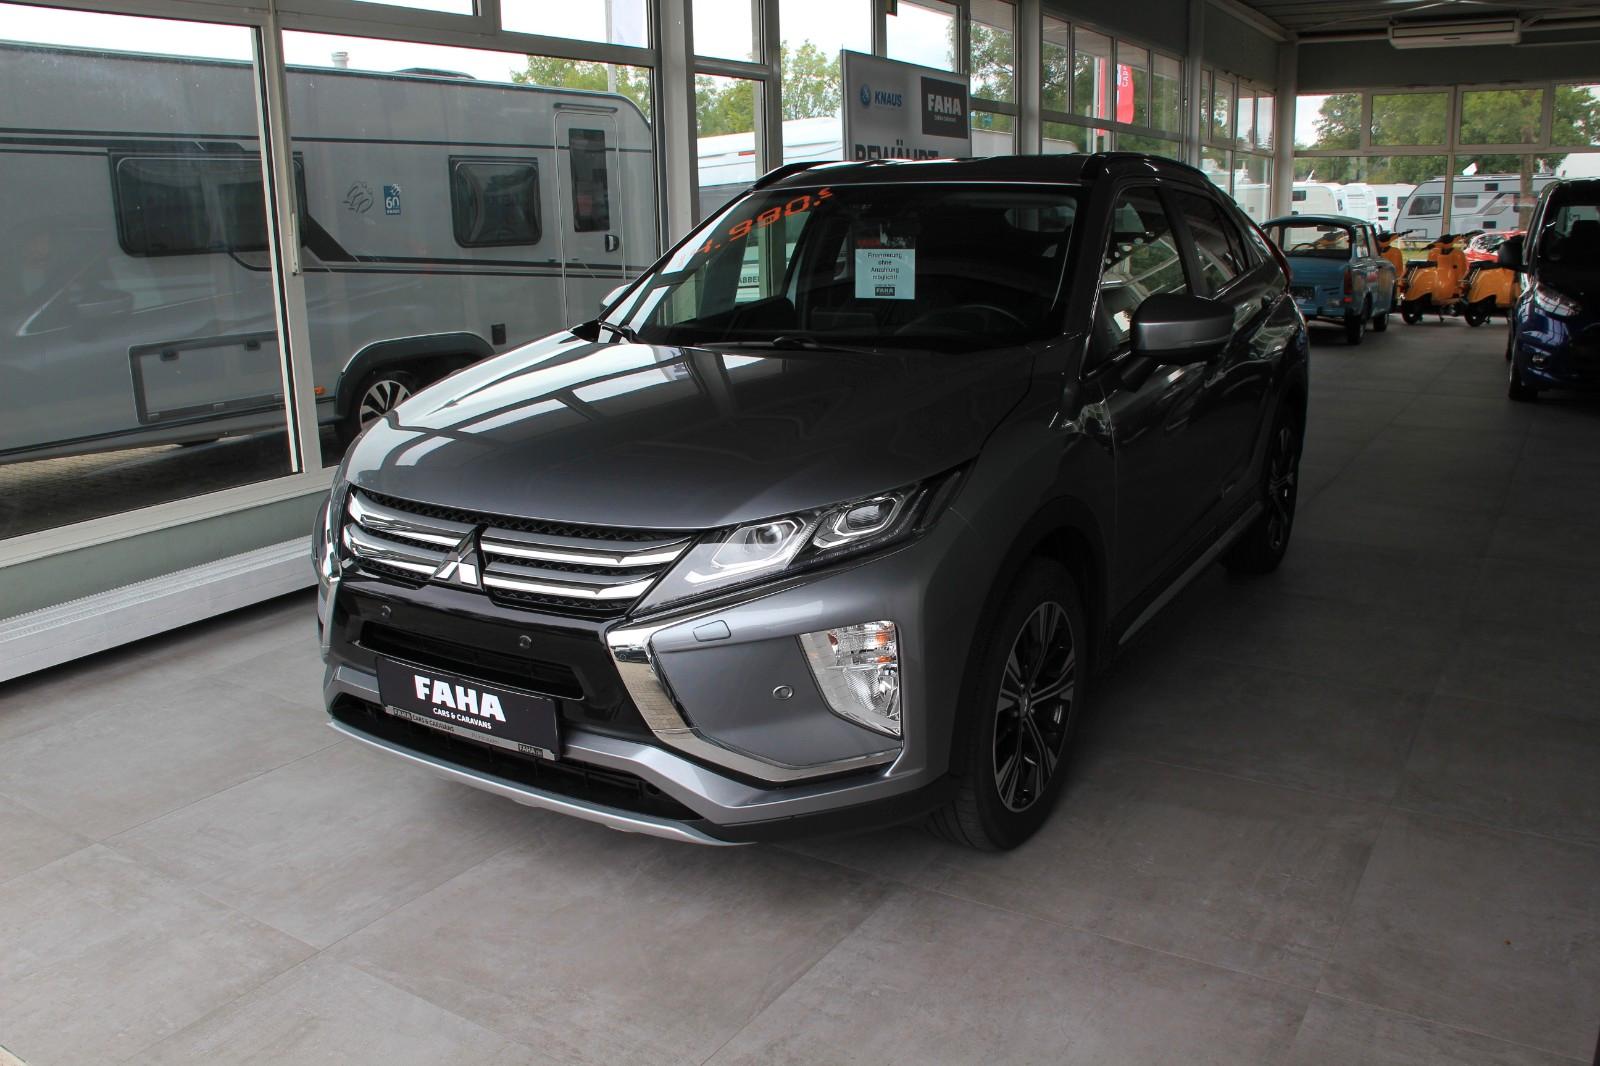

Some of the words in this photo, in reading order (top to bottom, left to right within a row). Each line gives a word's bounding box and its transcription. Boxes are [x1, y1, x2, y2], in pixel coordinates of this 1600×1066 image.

[874, 91, 903, 108] KNAUS
[927, 93, 962, 116] FAHA
[414, 674, 506, 723] FAHA
[394, 709, 412, 720] FAHA
[432, 707, 450, 719] CARS
[450, 712, 456, 720] &
[456, 713, 492, 730] CARAVANS
